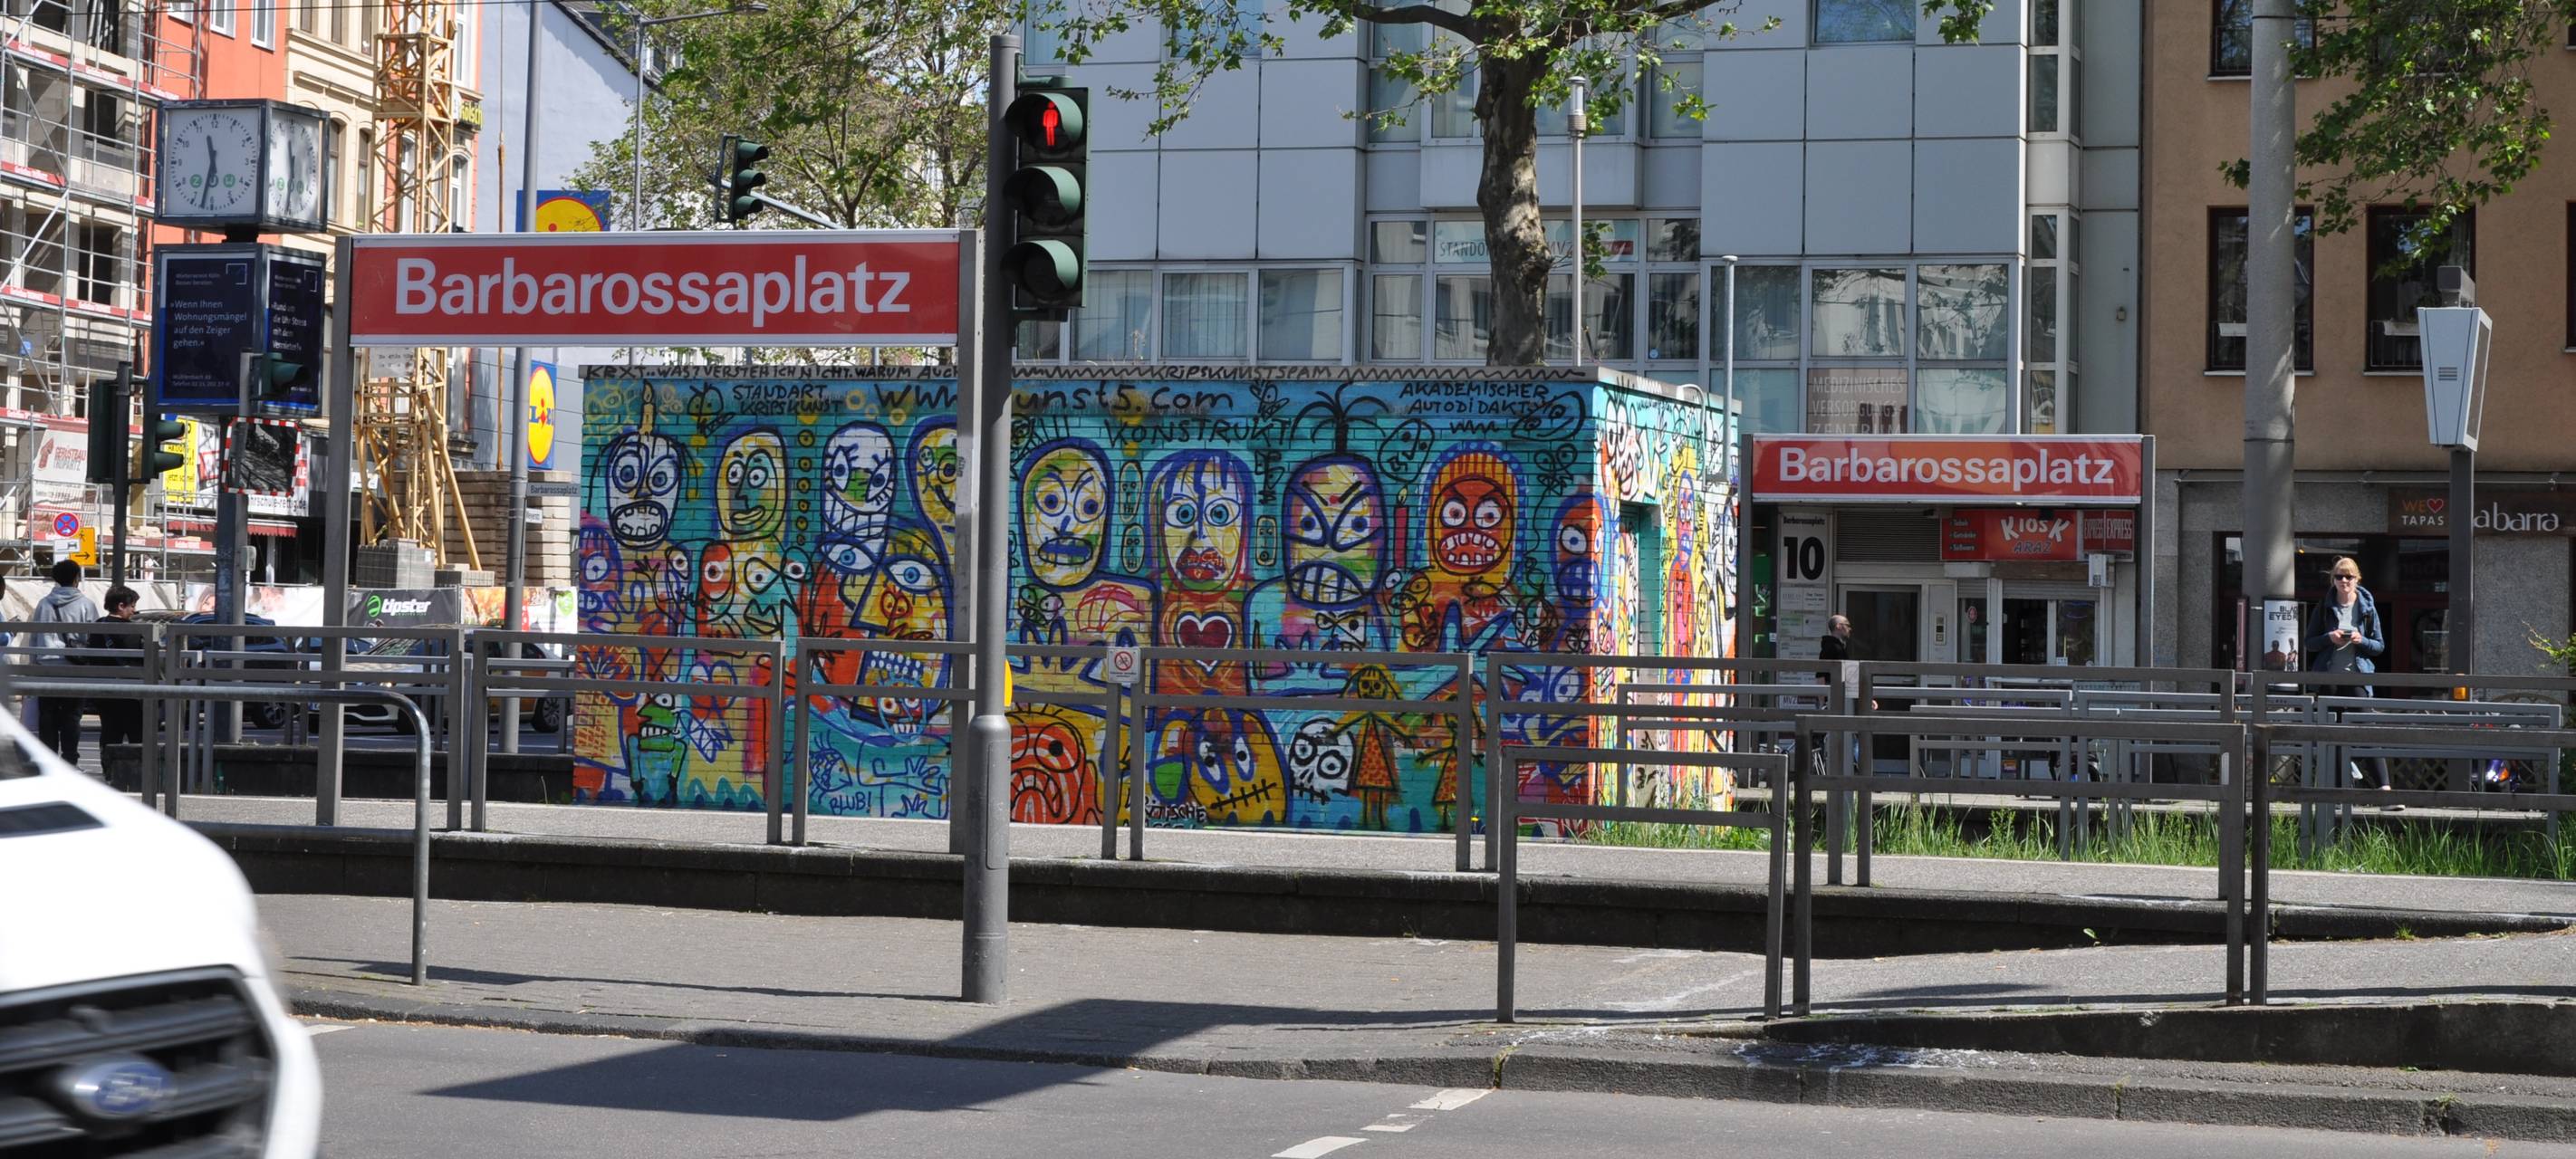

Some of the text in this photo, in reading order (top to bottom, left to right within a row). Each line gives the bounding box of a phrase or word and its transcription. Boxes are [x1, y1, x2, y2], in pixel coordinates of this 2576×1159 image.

[1439, 241, 1491, 256] STANDO
[395, 254, 910, 328] Barbarossaplatz
[199, 300, 223, 309] Ihnen
[174, 311, 247, 324] Wohnungsmängel
[173, 325, 231, 337] auf den Zeiger
[704, 365, 770, 378] VERSTEH
[855, 365, 912, 378] WARUM
[733, 383, 828, 401] STANDART
[1812, 376, 1904, 393] MEDIZINISCHES
[1812, 398, 1903, 417] VERSORGUNGS-
[1105, 417, 1293, 446] KONSTRUKT
[1780, 447, 2114, 492] Barbarossaplatz
[530, 484, 578, 496] Barbarossaplatz
[2402, 500, 2426, 512] WE
[1783, 515, 1825, 526] Barbarossaplatz
[2402, 515, 2444, 526] TAPAS
[2494, 502, 2559, 532] barra
[2000, 516, 2071, 543] KIOSK
[2107, 519, 2132, 539] EXPRESS
[2014, 541, 2052, 554] ARAZ
[1783, 536, 1825, 580] 10
[381, 599, 431, 616] tipster
